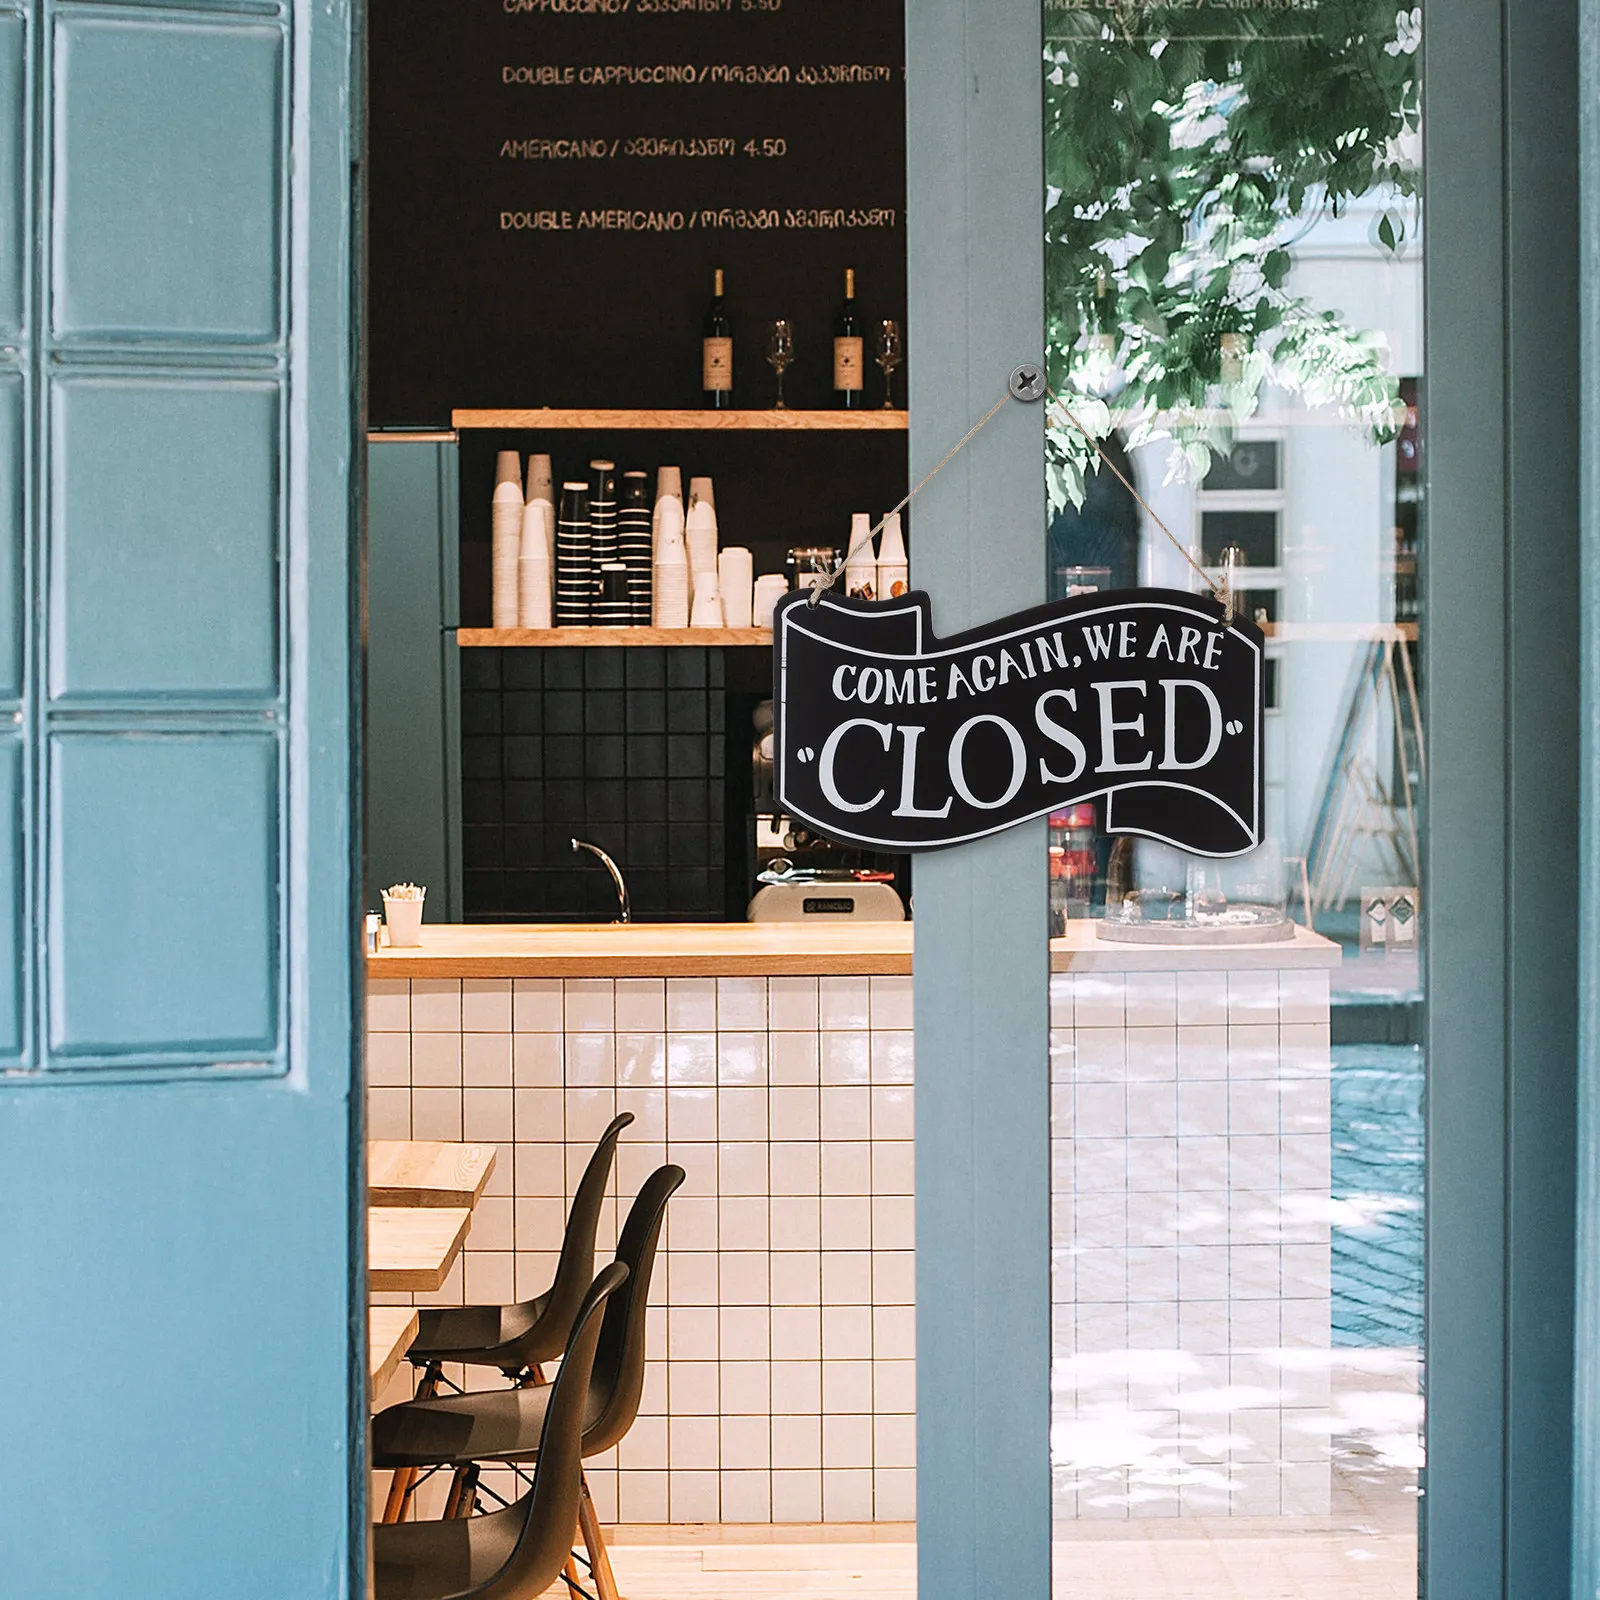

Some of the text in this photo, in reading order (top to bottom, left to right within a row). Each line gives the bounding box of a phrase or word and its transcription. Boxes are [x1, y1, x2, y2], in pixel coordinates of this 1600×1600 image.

[502, 65, 575, 85] DOUBLE
[579, 64, 697, 85] CAPPUCCINO
[500, 139, 607, 158] AMERICANO
[743, 139, 787, 157] 4.50
[500, 210, 573, 230] DOUBLE
[577, 209, 684, 231] AMERICANO
[832, 621, 1224, 705] COME AGAIN, WE ARE
[818, 678, 1223, 819] CLOSED
